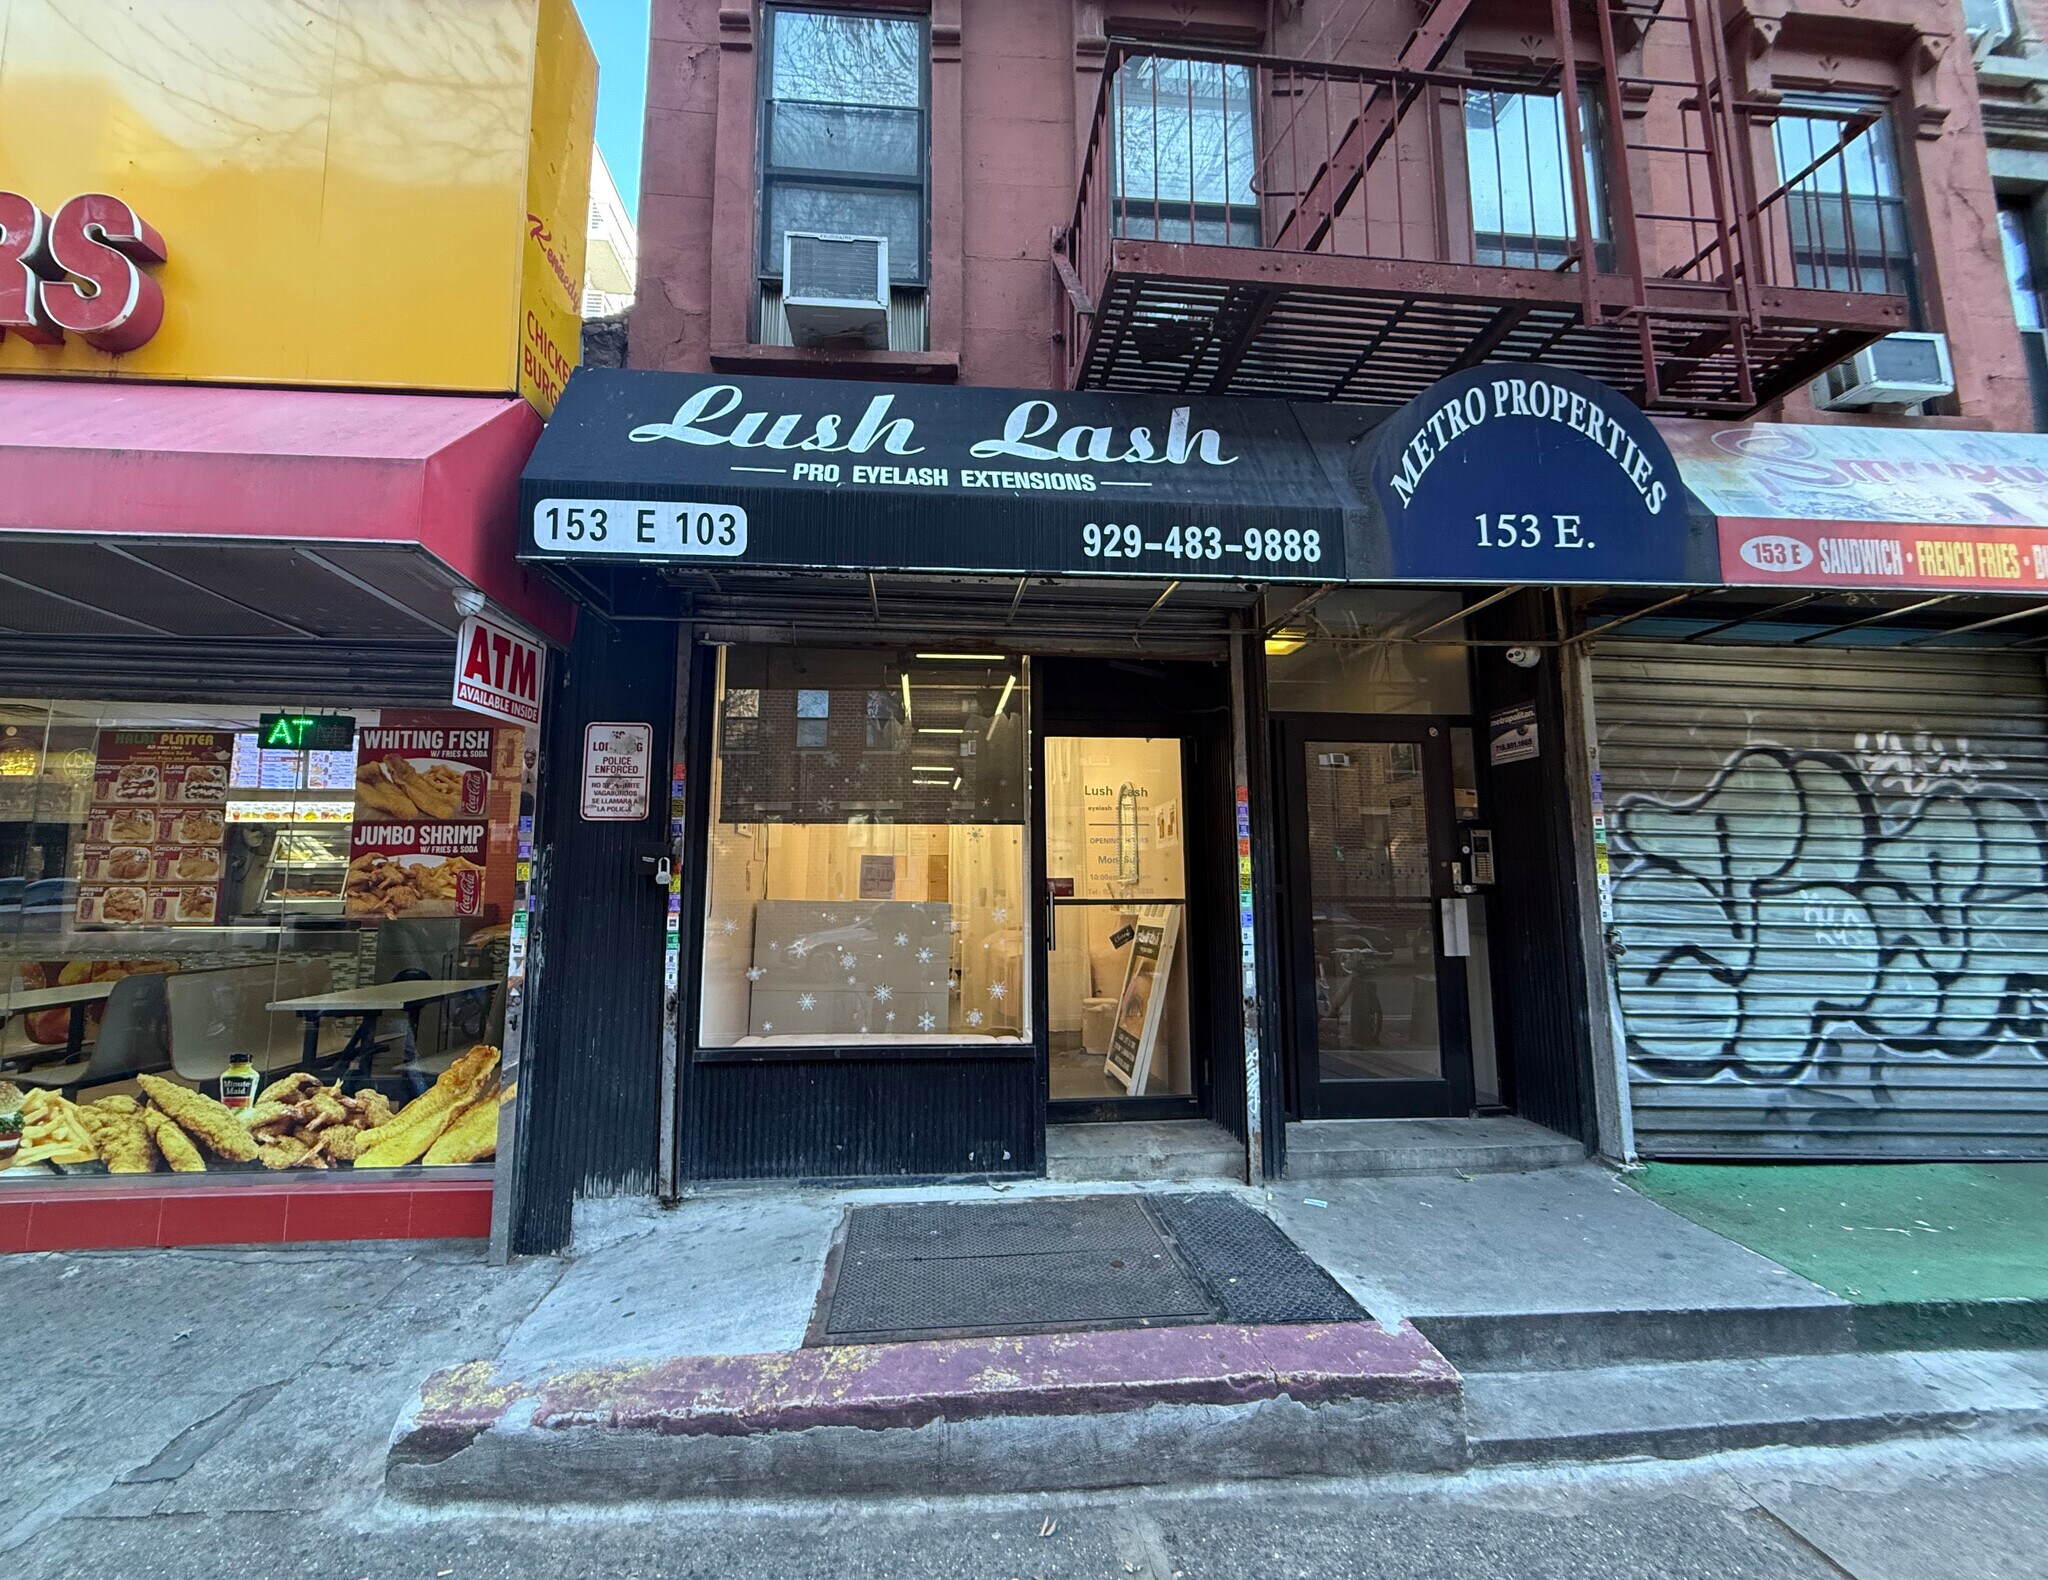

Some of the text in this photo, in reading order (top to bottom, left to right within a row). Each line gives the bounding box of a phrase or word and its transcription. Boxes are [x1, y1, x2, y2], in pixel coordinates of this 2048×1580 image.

[526, 211, 581, 313] Kennedy
[527, 310, 572, 386] CHICKE
[524, 344, 563, 408] BURG
[628, 385, 1239, 465] Lush Lash
[1389, 386, 1486, 509] METRO
[1491, 379, 1667, 515] PROPERTIES
[793, 463, 1096, 492] PRO EYELASH EXTENSIONS
[545, 507, 736, 546] 153 E 103
[1475, 513, 1595, 549] 153 E.
[1082, 523, 1321, 563] 929-483-9888
[1751, 543, 1803, 565] 153 E
[1818, 537, 1905, 576] SANDWICH
[1914, 540, 1977, 578] FRENCH
[1976, 542, 2021, 579] FRIES
[463, 624, 537, 702] ATM
[459, 684, 538, 721] AVAILABLE INSIDE
[160, 733, 214, 746] PLATTER
[363, 730, 490, 750] WHITING FISH
[430, 750, 488, 758] W/ FRIES & SODA
[594, 765, 638, 774] ENFORCED
[602, 756, 632, 766] POLICE
[1084, 785, 1113, 796] Lush
[354, 825, 485, 846] JUMBO SHRIMP
[420, 845, 478, 854] W/ FRIES & SODA
[226, 1087, 246, 1095] Maid
